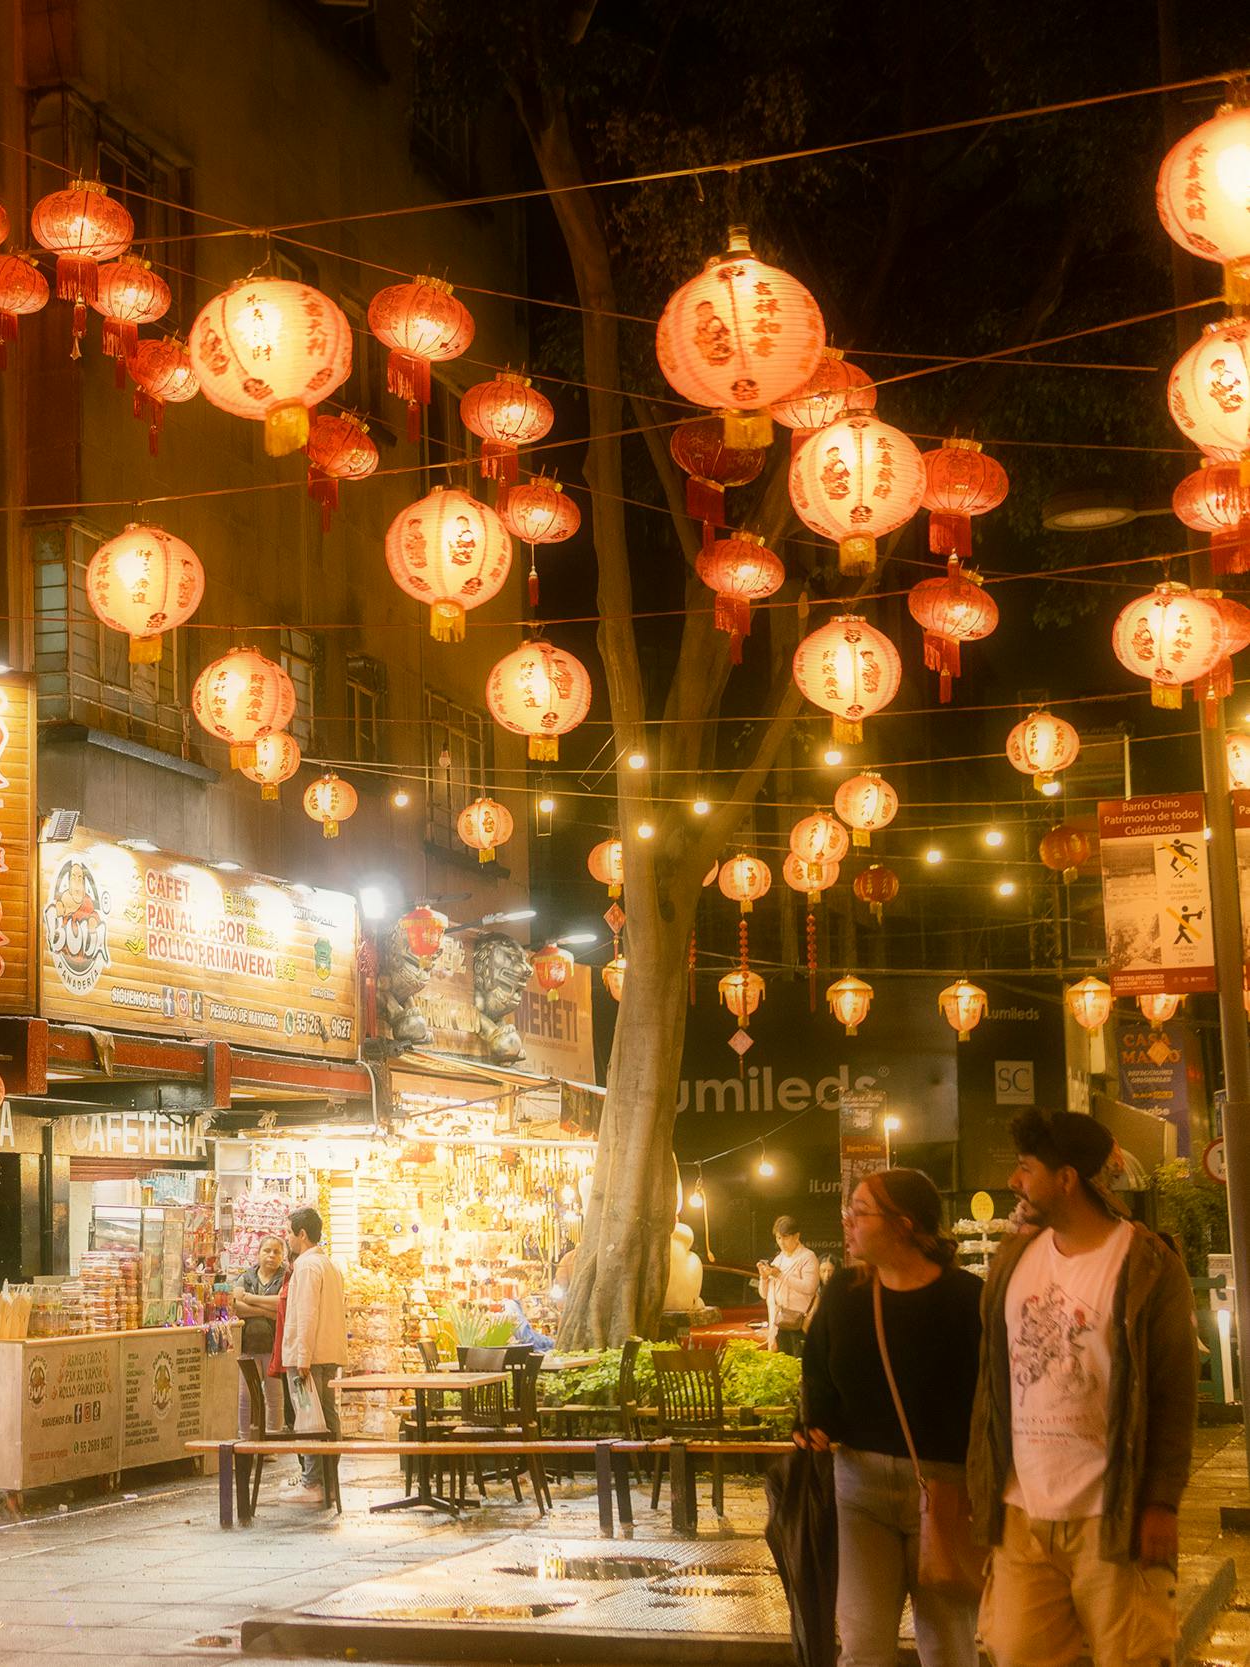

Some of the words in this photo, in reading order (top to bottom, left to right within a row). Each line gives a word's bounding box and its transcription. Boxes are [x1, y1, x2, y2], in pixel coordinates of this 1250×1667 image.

[747, 280, 781, 357] 吉祥如意
[1103, 813, 1155, 825] Patrimonio
[1157, 812, 1169, 821] de
[1170, 810, 1200, 820] todos
[1121, 801, 1150, 812] Barrio
[1151, 799, 1181, 810] Chino
[146, 870, 191, 902] CAFET
[147, 904, 175, 931] PAN
[179, 911, 198, 935] AL
[148, 934, 195, 963] ROLLO
[198, 943, 274, 978] PRIMAVERA
[238, 1008, 249, 1022] DE
[296, 1013, 308, 1033] 55
[331, 1017, 352, 1040] 9627
[998, 1067, 1031, 1094] SC
[71, 1111, 207, 1156] CAFETERIA
